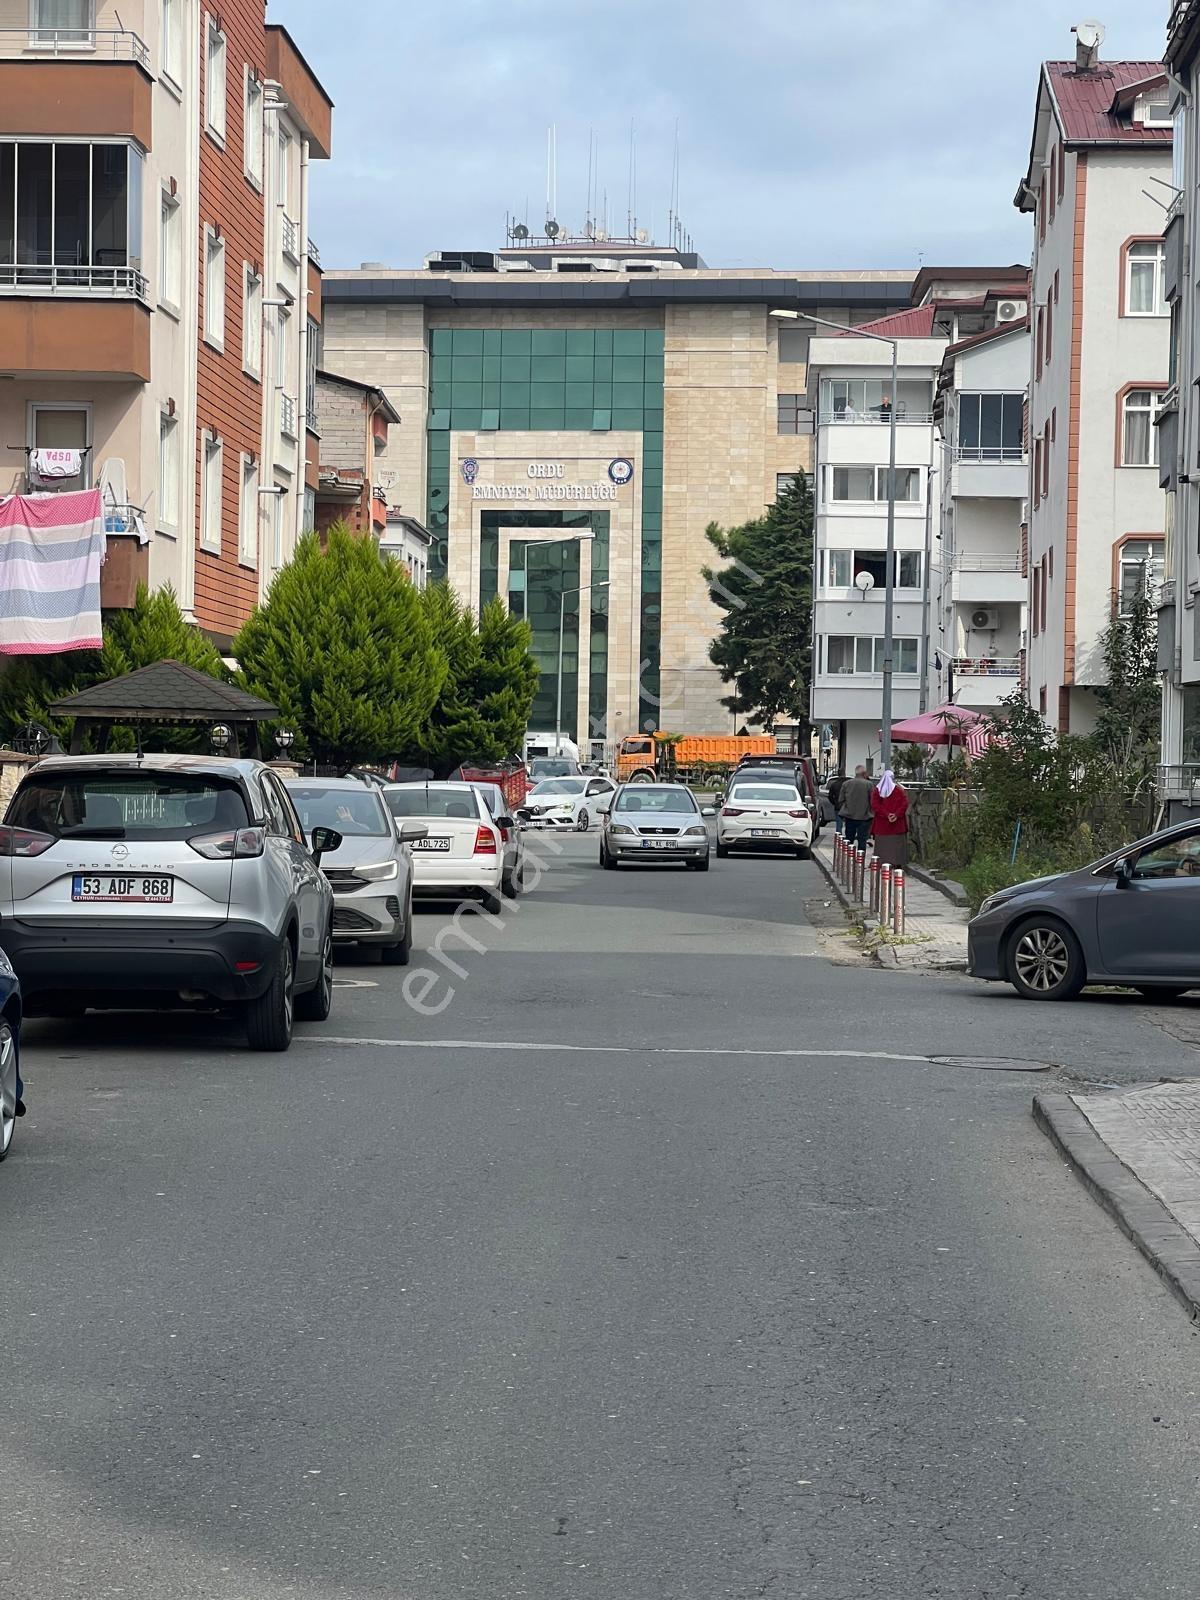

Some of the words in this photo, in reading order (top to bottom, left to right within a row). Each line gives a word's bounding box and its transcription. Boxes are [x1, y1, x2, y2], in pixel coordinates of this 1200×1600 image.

[527, 463, 566, 479] ORDU
[472, 483, 531, 500] EMNİYET
[535, 482, 617, 500] MÜDÜRLÜĞÜ
[434, 840, 449, 848] 725
[82, 878, 101, 895] 53
[108, 878, 136, 895] ADF
[142, 879, 169, 896] 868
